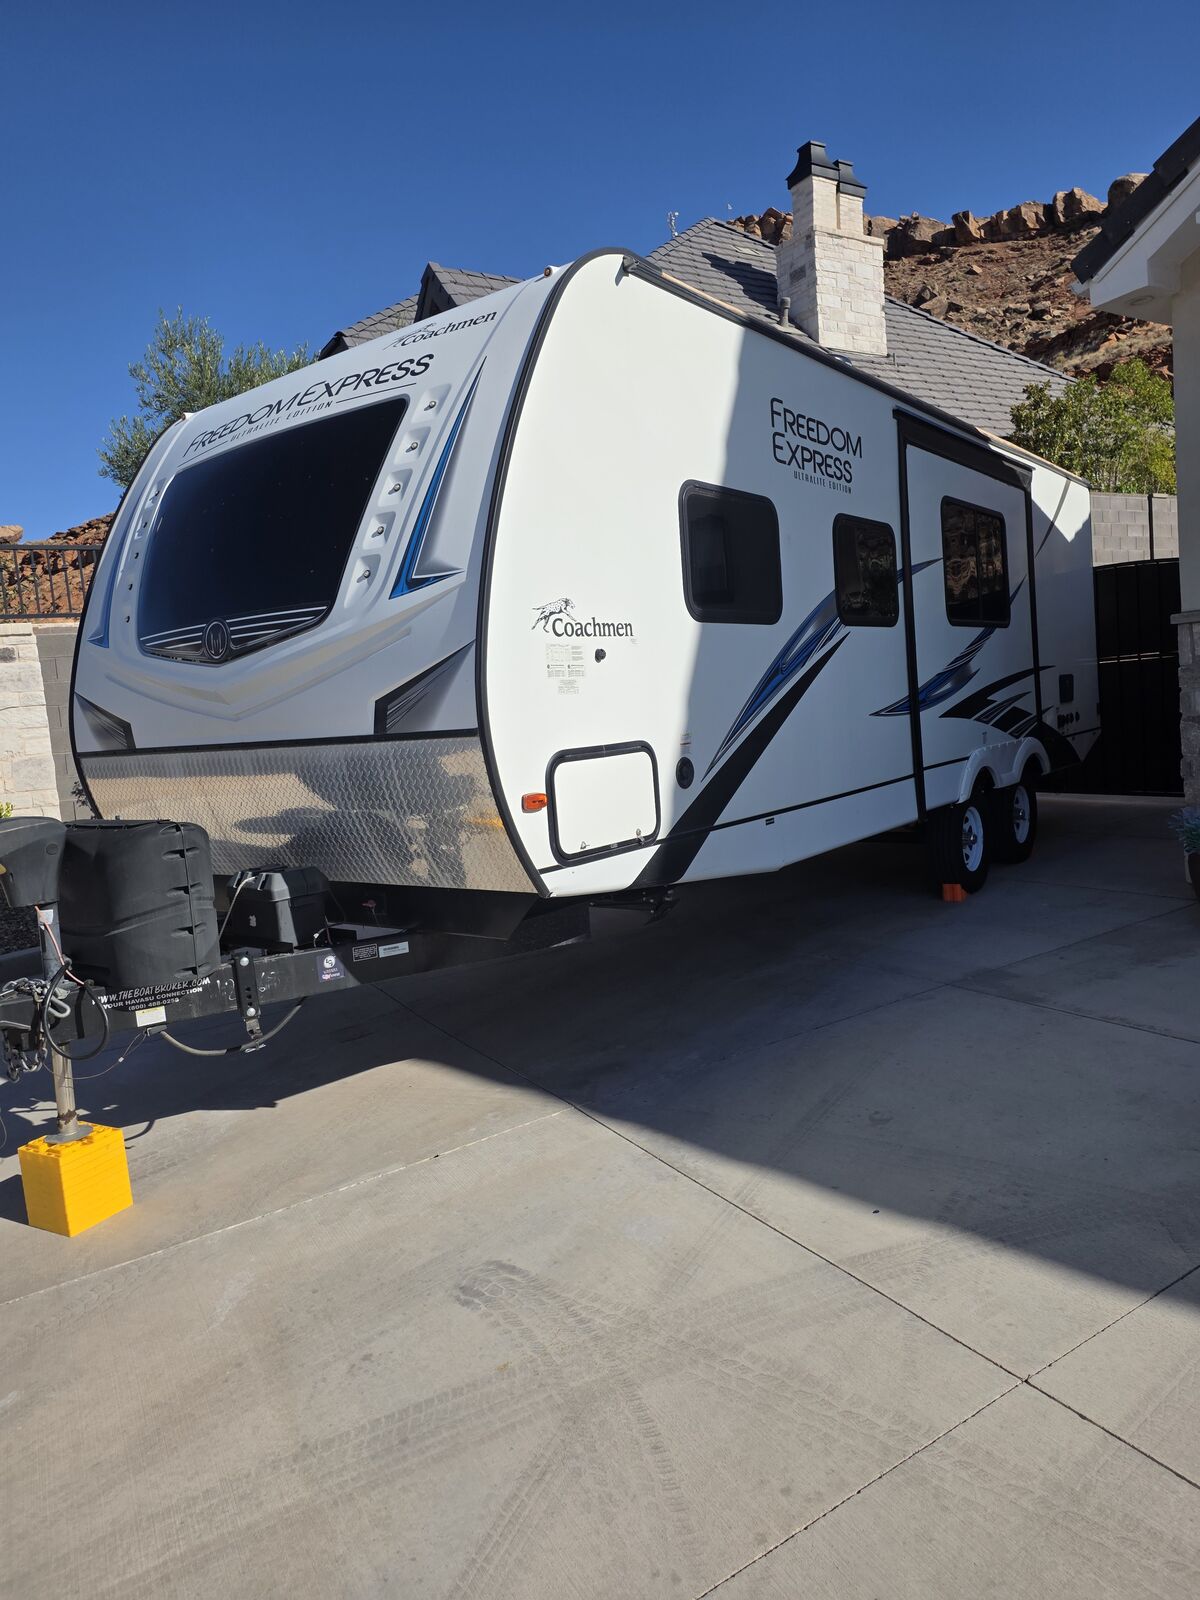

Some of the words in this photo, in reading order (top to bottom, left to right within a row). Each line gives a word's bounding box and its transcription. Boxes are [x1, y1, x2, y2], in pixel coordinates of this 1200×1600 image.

[400, 311, 497, 347] Coachmen
[230, 417, 280, 442] ULTRALITE
[286, 400, 334, 421] EDITION
[770, 397, 863, 459] FREEDOM
[772, 431, 853, 484] EXPRESS
[793, 470, 826, 488] ULTRALITE
[828, 480, 852, 495] EDITION
[551, 616, 635, 637] Coachmen
[103, 1000, 124, 1009] YOUR
[125, 995, 155, 1006] HAVASU
[156, 986, 203, 999] CONNECTION
[128, 1003, 146, 1011] (800)
